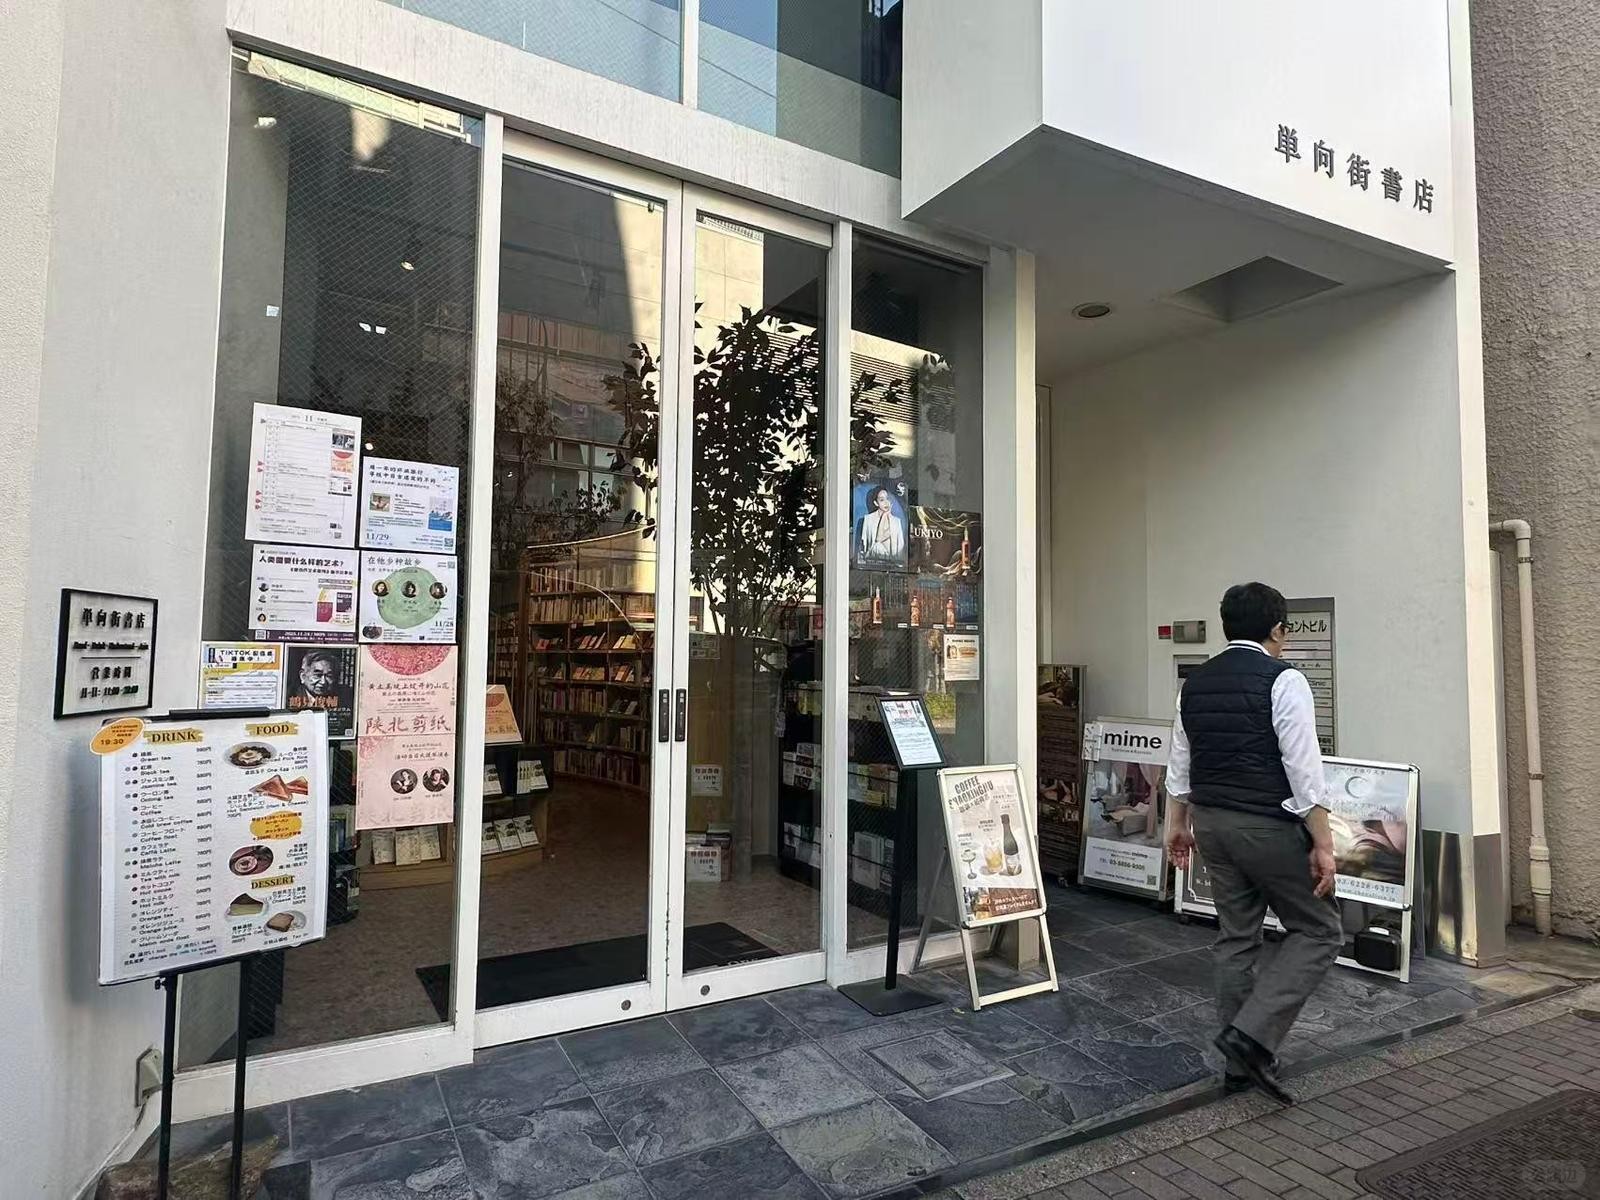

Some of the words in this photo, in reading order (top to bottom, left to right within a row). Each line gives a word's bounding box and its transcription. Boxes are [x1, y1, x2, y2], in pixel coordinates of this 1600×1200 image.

[1275, 124, 1433, 213] 単向街書店
[914, 528, 944, 540] UKIYO
[256, 725, 289, 735] FOOD
[152, 732, 196, 743] DRINK
[1104, 730, 1162, 749] mime
[954, 776, 980, 794] COFFEE
[251, 876, 295, 889] DESSERT
